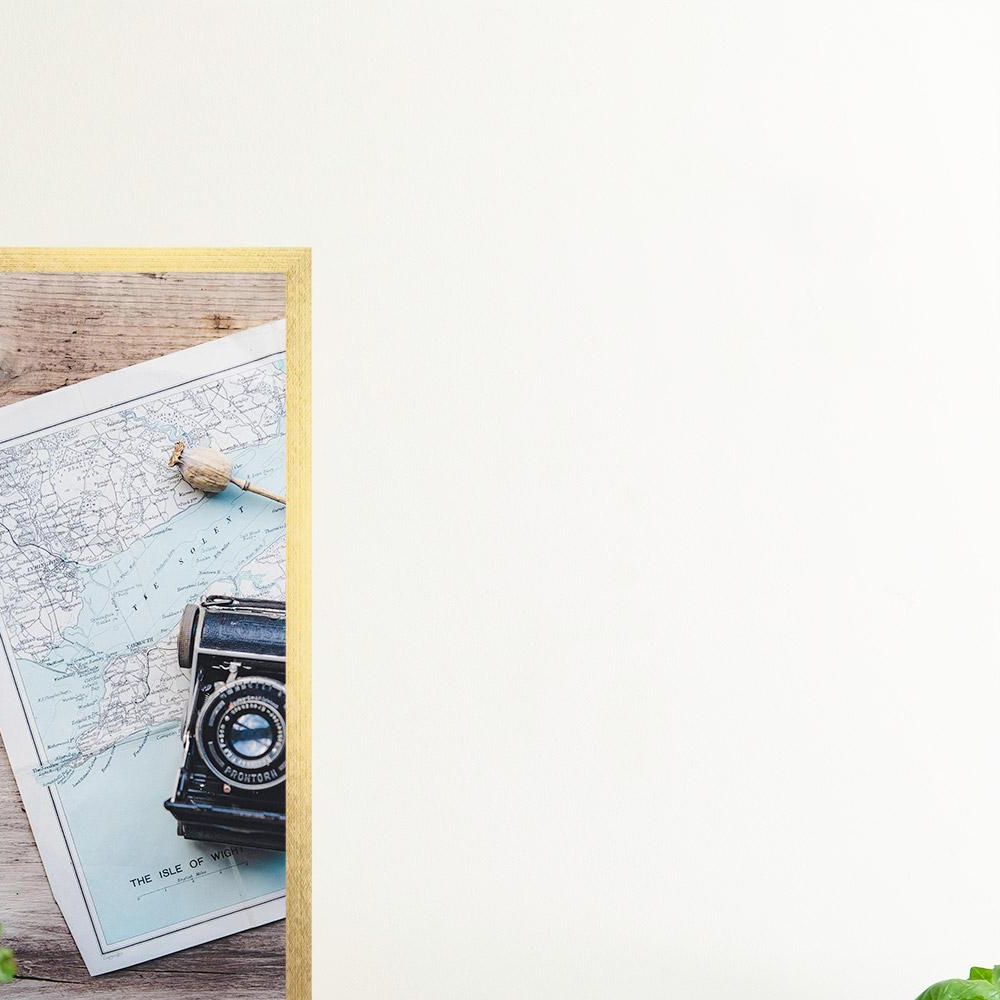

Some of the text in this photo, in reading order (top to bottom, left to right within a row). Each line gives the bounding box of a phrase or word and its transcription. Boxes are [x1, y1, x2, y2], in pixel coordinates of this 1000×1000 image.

[178, 506, 245, 565] SOLENT
[129, 874, 152, 888] THE
[159, 863, 183, 880] ISLE
[189, 857, 204, 869] OF
